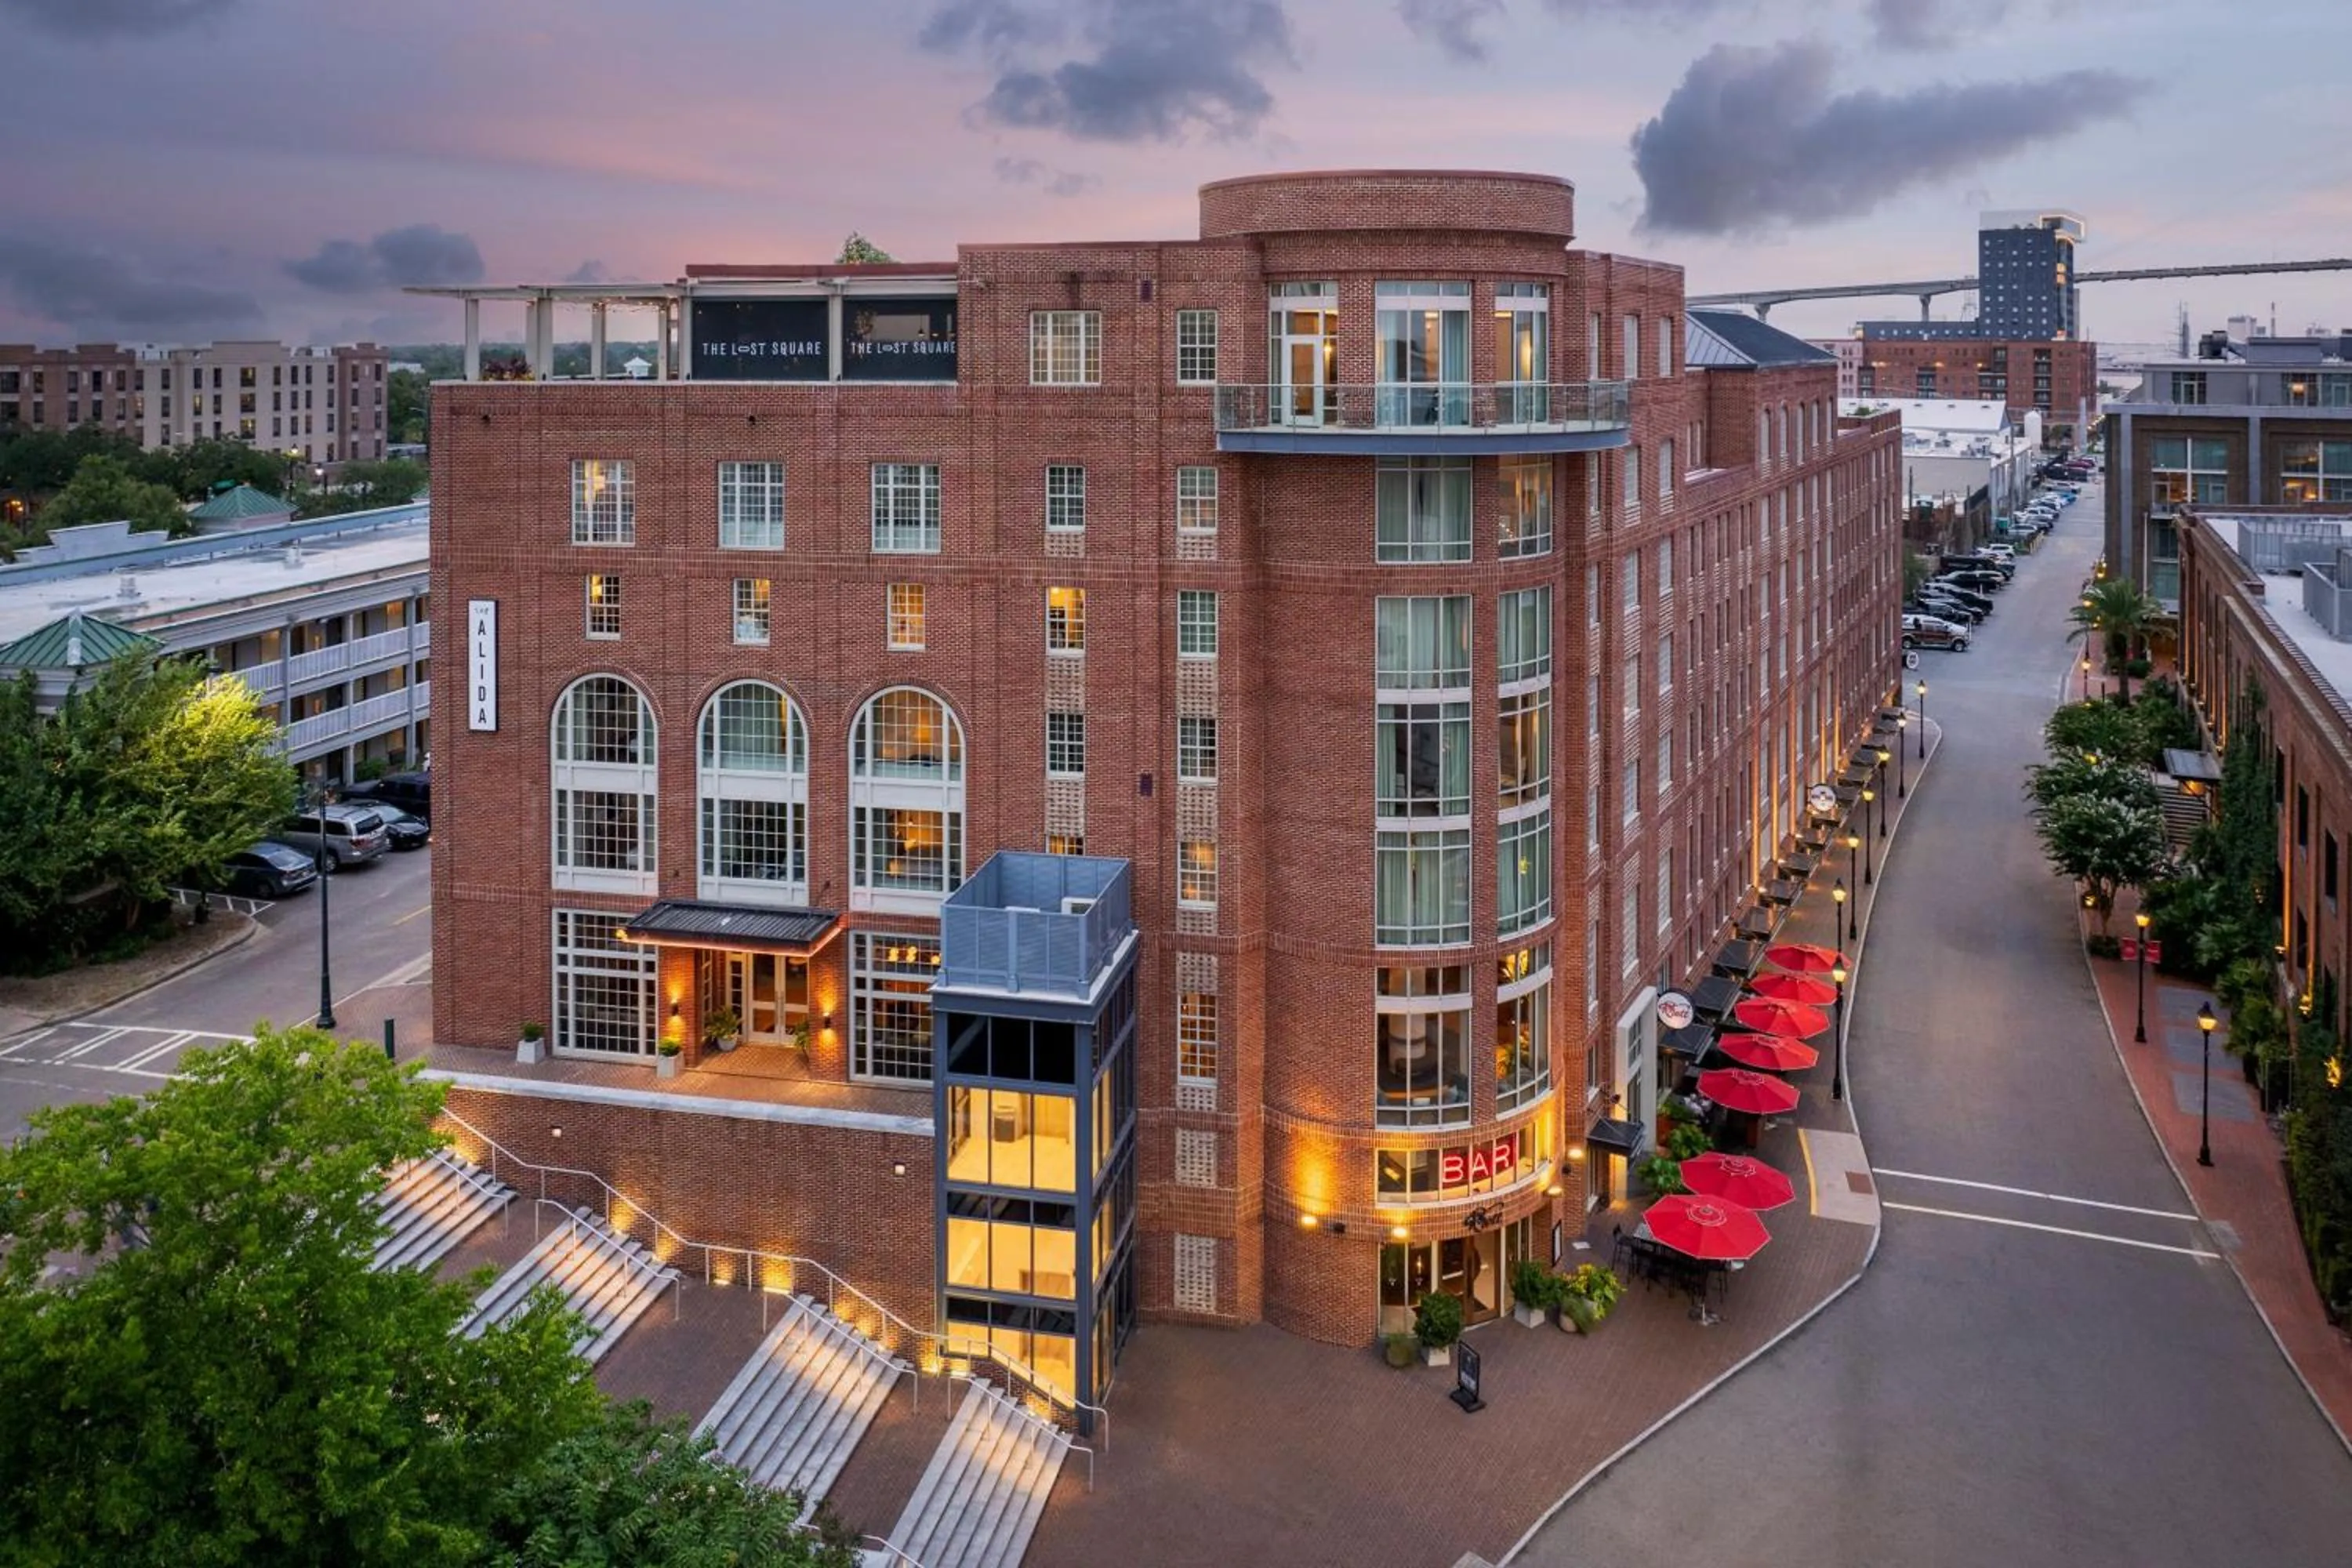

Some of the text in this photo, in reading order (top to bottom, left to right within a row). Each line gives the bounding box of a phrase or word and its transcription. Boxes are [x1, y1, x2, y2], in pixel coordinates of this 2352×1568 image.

[702, 341, 822, 356] THE LOST SQUARE
[851, 341, 956, 354] THE LOST SQUARE
[1443, 1145, 1510, 1182] BAR
